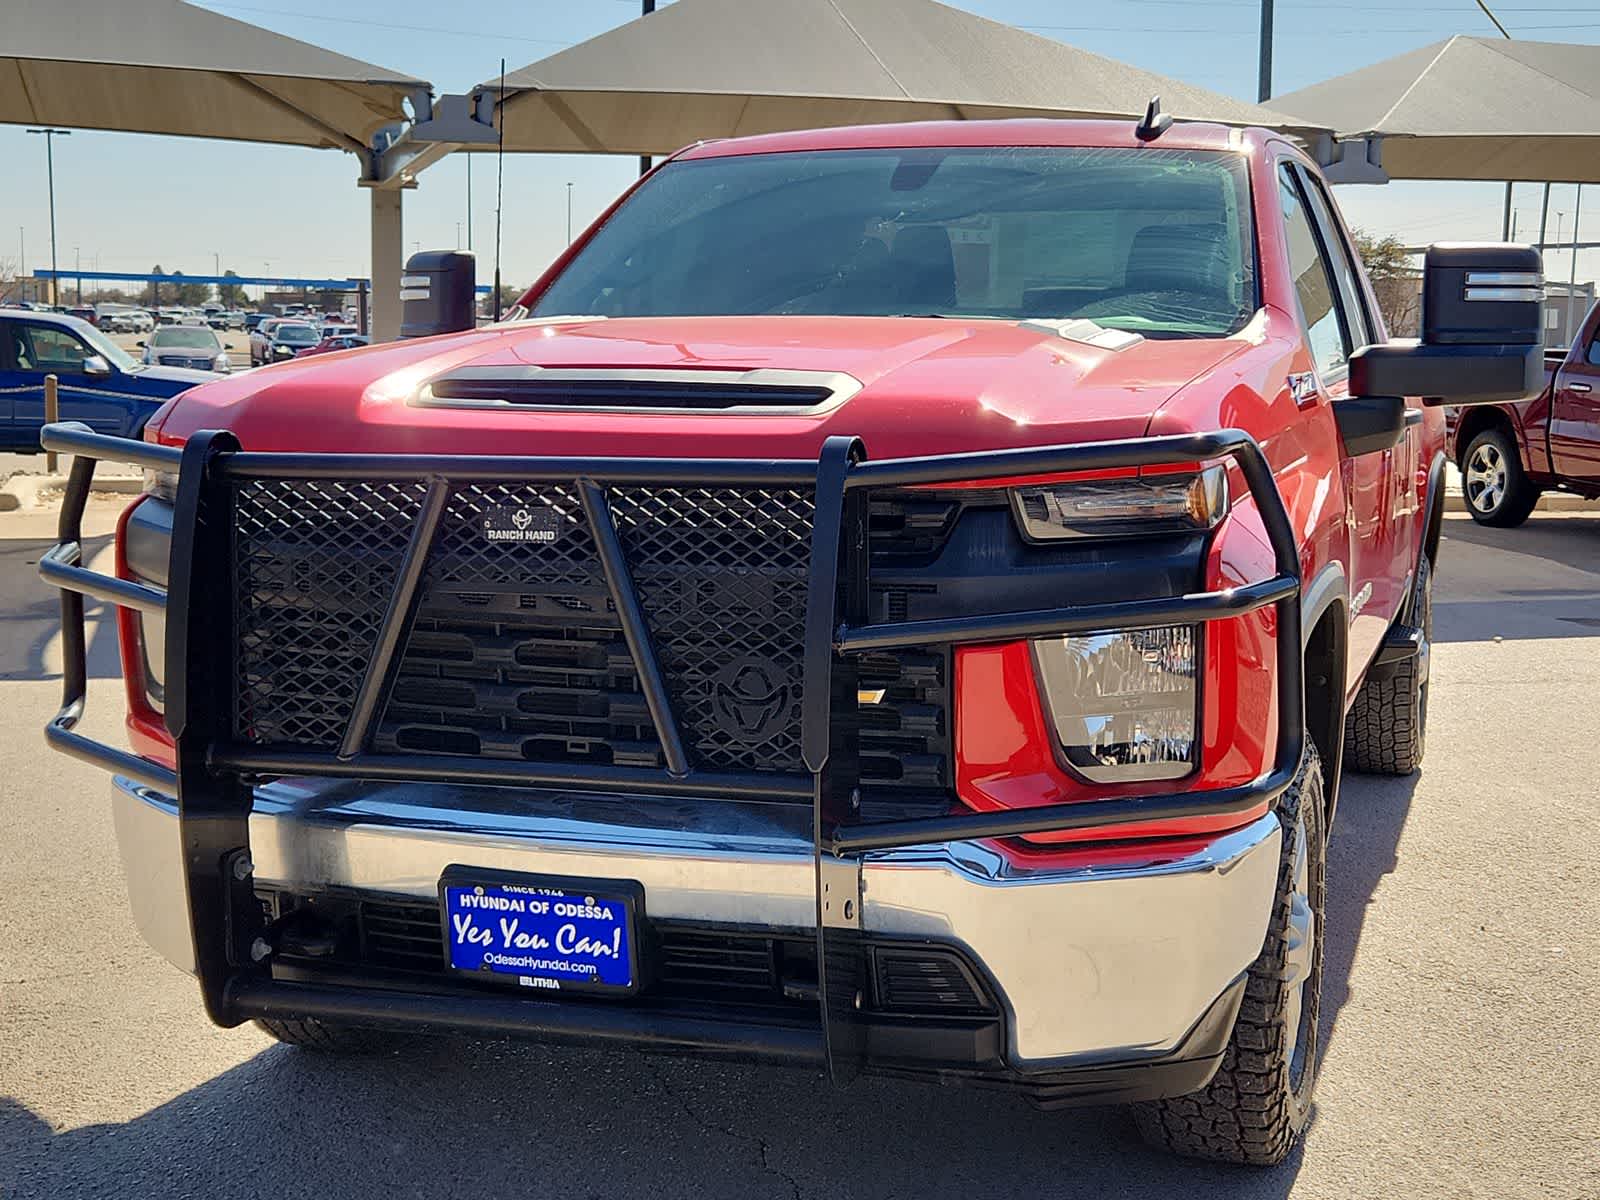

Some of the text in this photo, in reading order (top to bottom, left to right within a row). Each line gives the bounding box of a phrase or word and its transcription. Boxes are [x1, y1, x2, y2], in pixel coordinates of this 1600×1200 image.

[487, 530, 555, 541] RANCH HAND
[501, 885, 536, 895] SINCE
[460, 895, 614, 920] HYUNDAI OF ODESSA
[453, 914, 621, 959] Yes You Can!
[483, 952, 597, 974] OdessaHyundai.com
[529, 976, 560, 989] LITHIA
